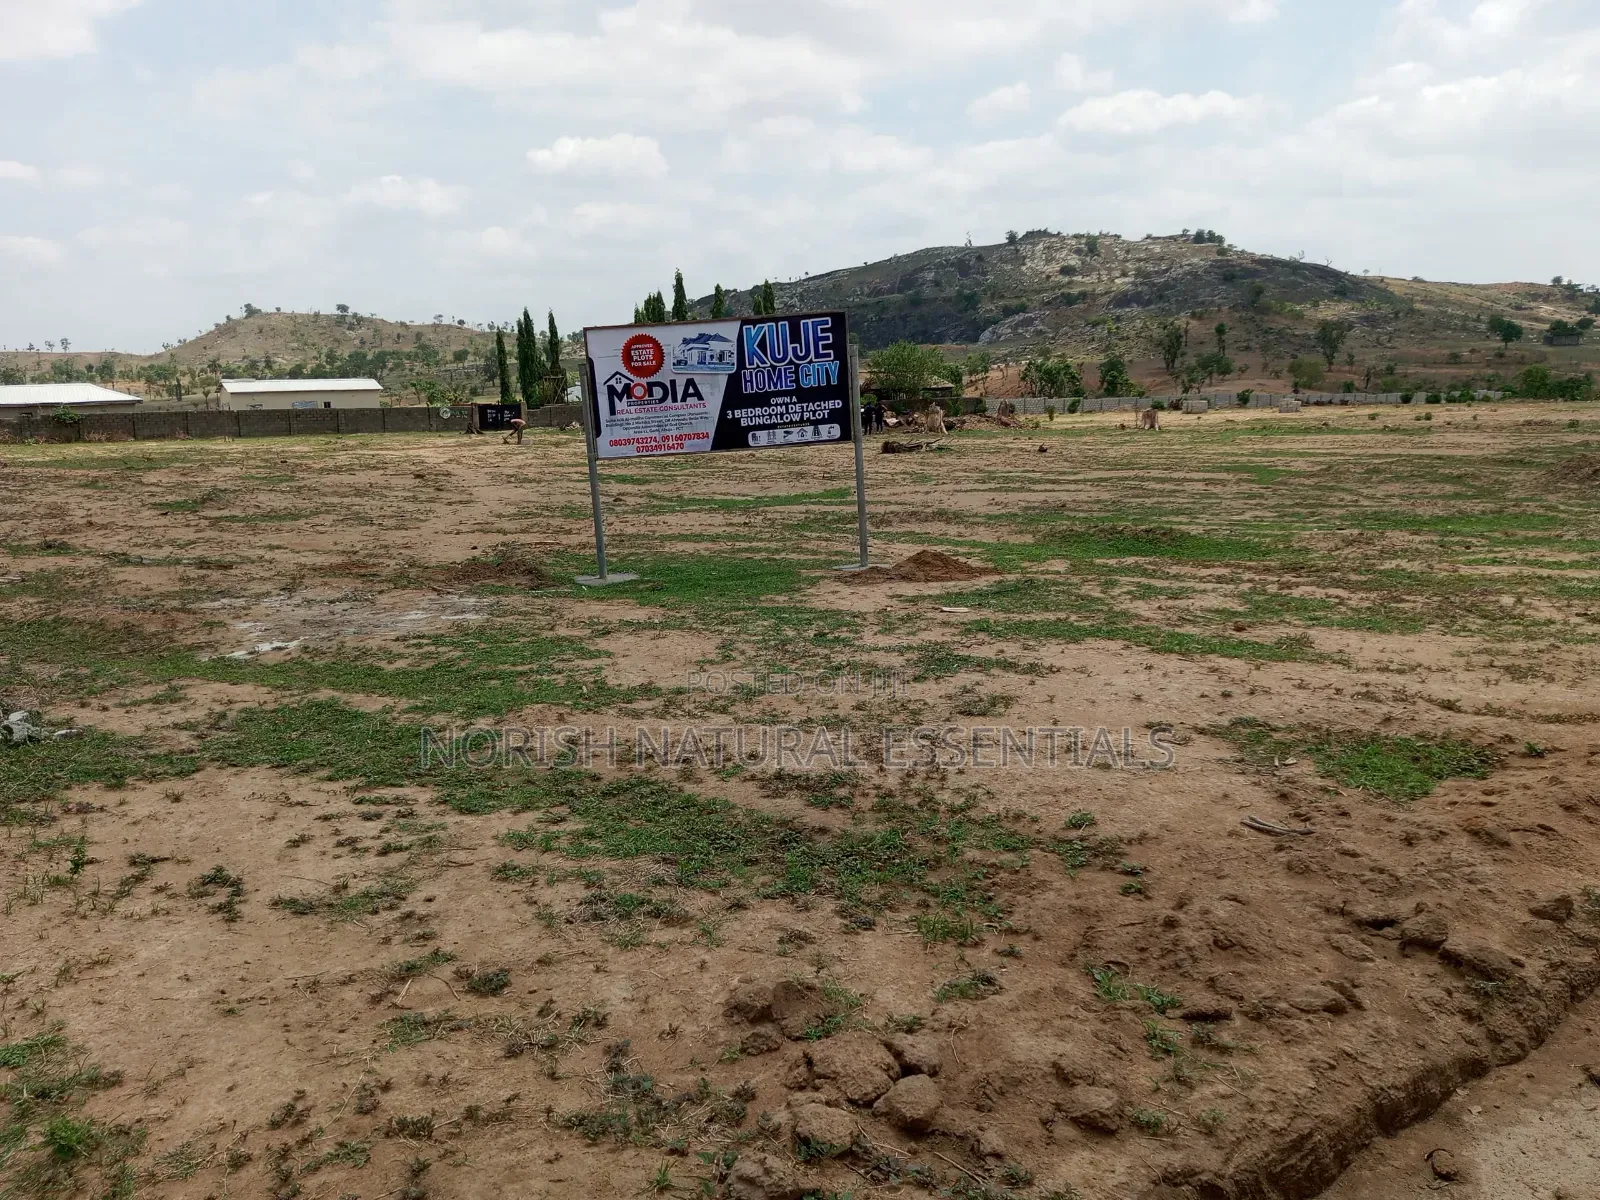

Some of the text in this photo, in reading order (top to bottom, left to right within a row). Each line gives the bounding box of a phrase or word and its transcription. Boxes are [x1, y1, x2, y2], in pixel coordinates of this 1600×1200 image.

[743, 317, 834, 368] KUJE
[742, 361, 839, 394] HOME CITY
[606, 377, 705, 416] MODIA
[770, 397, 790, 405] OWN
[634, 406, 658, 414] ESTATE
[659, 402, 707, 411] CONSULTANTS
[726, 400, 842, 419] 3 BEDROOM DETACHED
[740, 412, 801, 427] BUNGALOW
[803, 409, 830, 421] PLOT
[609, 432, 710, 447] 08039743274, 09160707834
[636, 442, 685, 453] 07034916470
